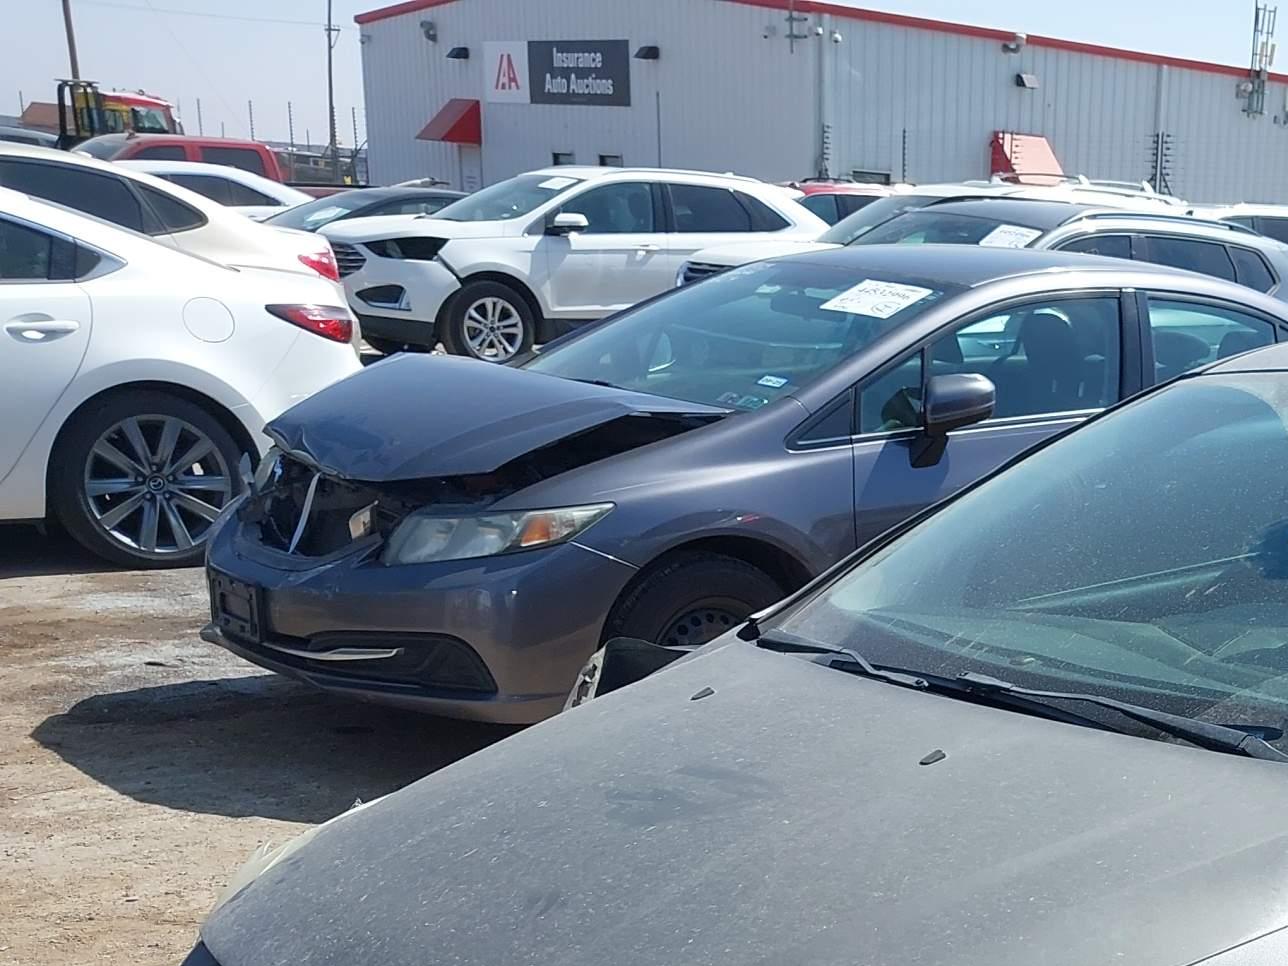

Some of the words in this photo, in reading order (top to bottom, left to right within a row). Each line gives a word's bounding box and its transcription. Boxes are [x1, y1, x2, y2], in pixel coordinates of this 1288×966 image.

[552, 47, 602, 68] Insurance
[544, 72, 568, 94] Auto
[569, 72, 614, 95] Auctions
